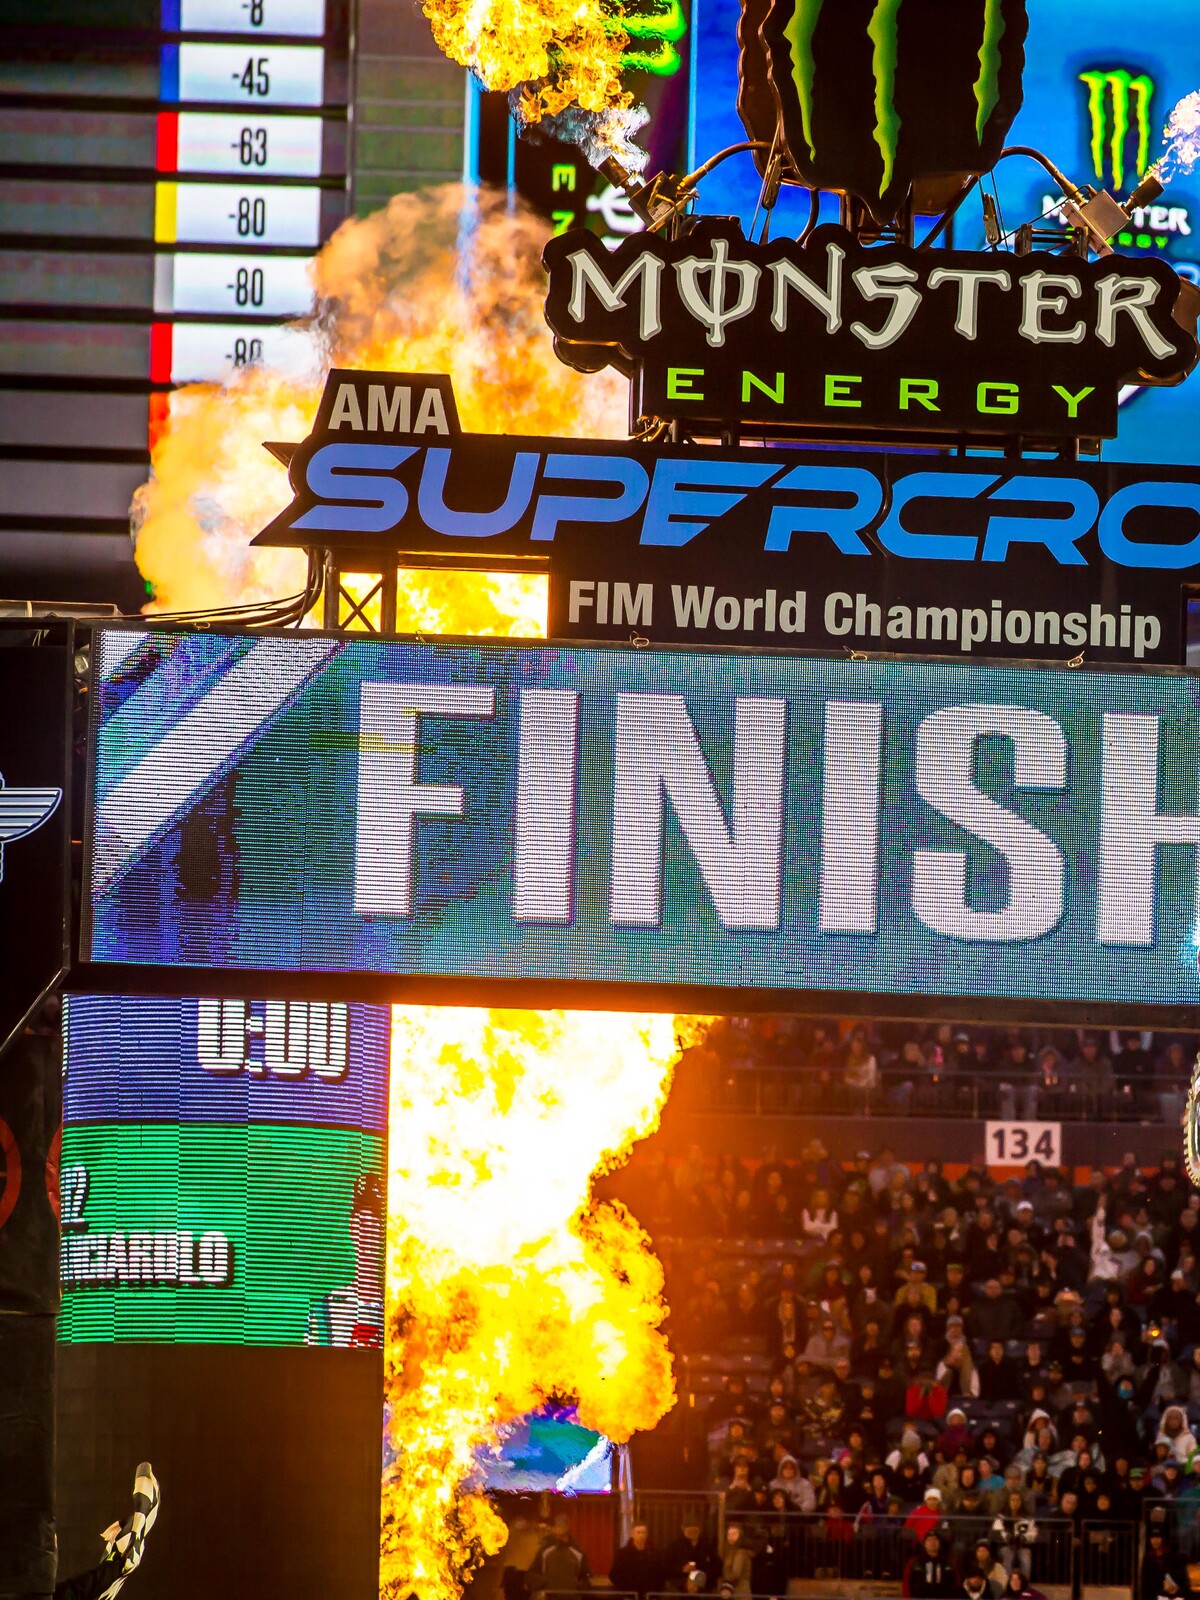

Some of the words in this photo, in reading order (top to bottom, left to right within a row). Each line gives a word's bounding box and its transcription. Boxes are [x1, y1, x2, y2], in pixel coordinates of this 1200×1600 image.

[231, 58, 270, 96] -45
[230, 128, 268, 166] -63
[228, 198, 266, 237] -80
[1043, 195, 1192, 235] MTER
[226, 268, 264, 307] -80
[565, 238, 1177, 360] MONSTER
[328, 382, 450, 436] AMA
[666, 367, 1095, 419] ENERGY
[568, 580, 653, 627] FIM
[671, 585, 807, 635] World
[824, 590, 1161, 657] Championship
[993, 1128, 1055, 1160] 134
